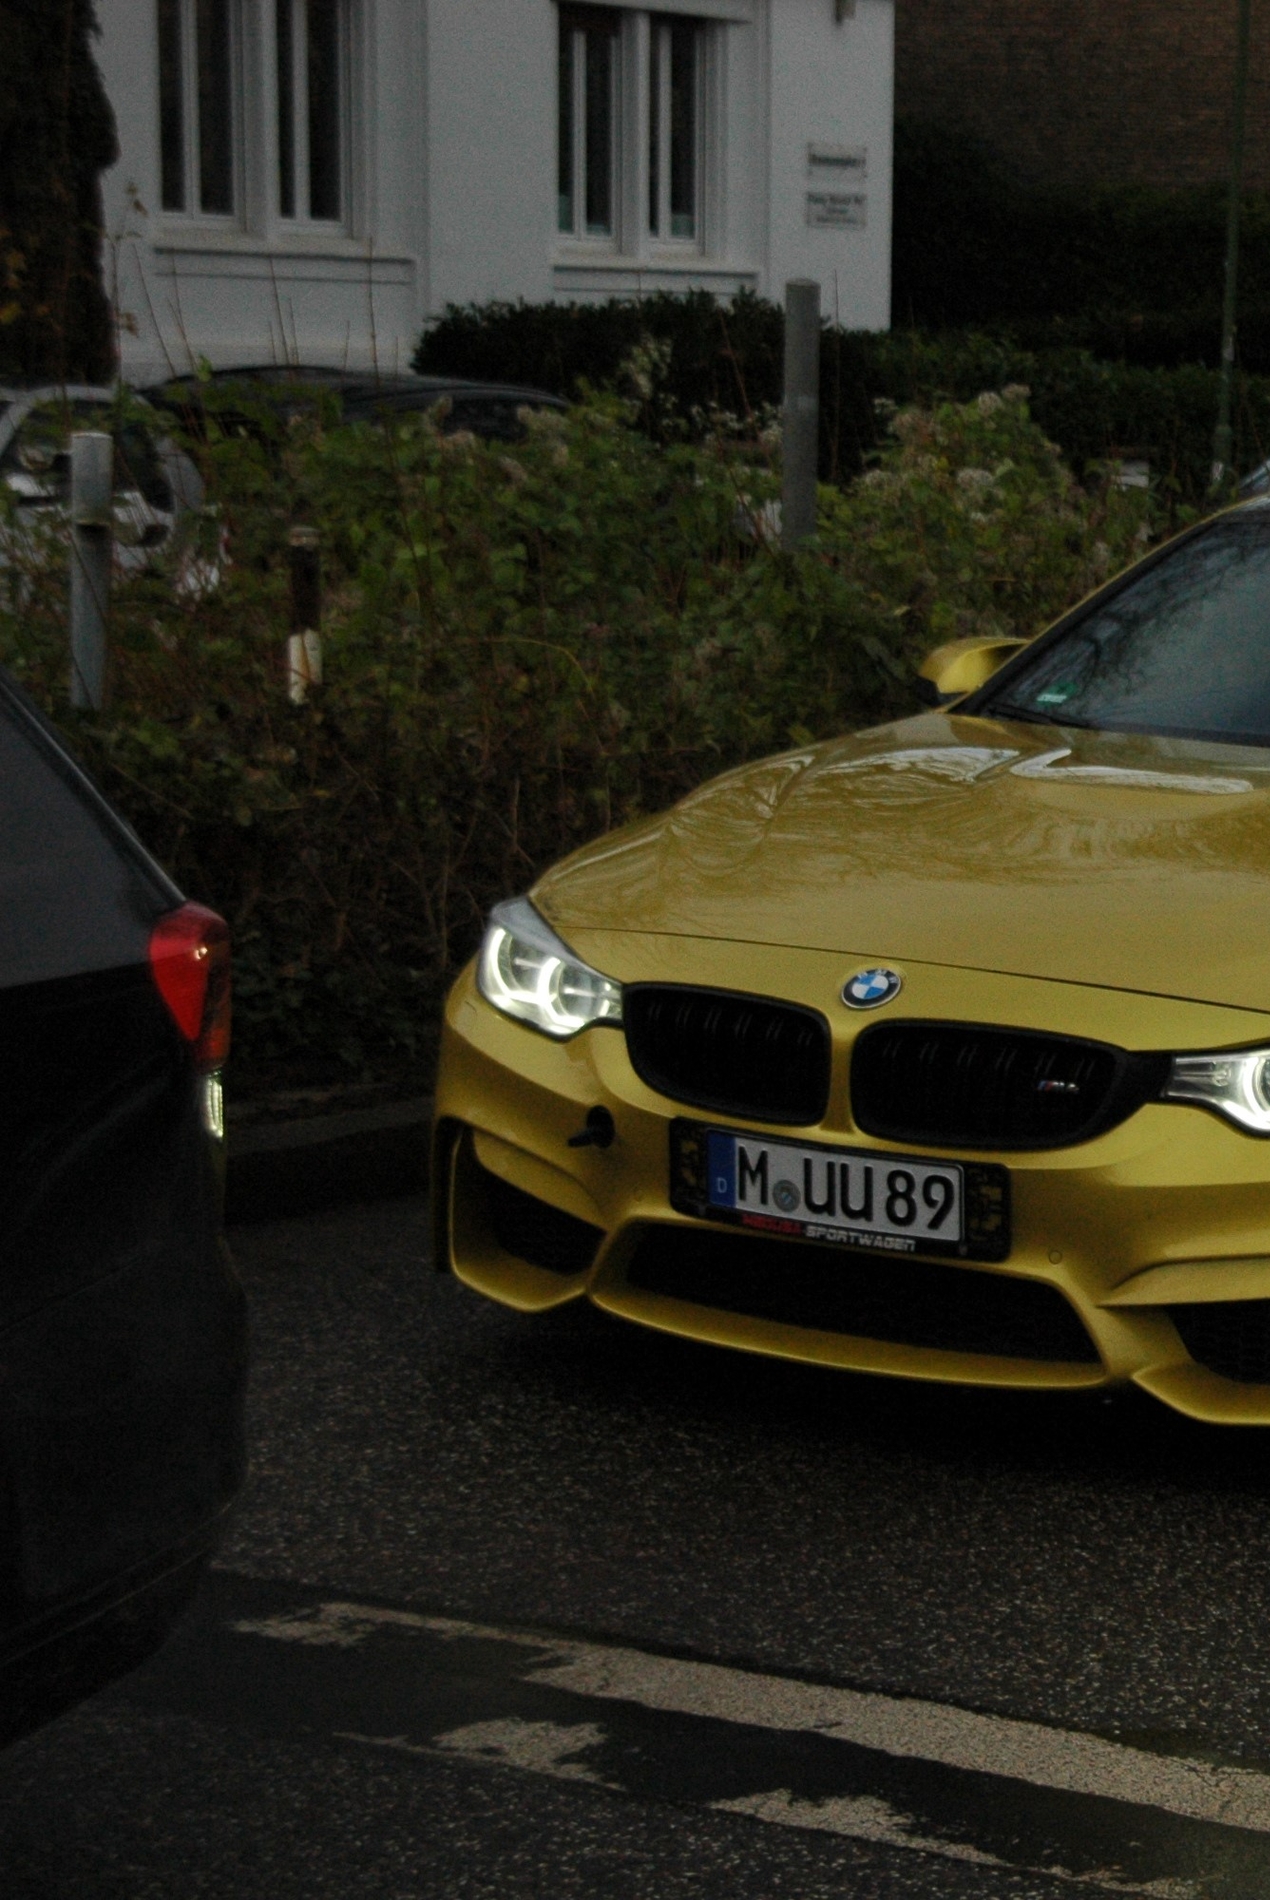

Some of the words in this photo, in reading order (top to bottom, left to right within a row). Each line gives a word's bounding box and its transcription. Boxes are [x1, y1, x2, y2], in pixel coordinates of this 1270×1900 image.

[715, 1177, 728, 1193] D
[738, 1145, 769, 1206] M
[803, 1157, 874, 1223] UU
[885, 1169, 955, 1231] 89
